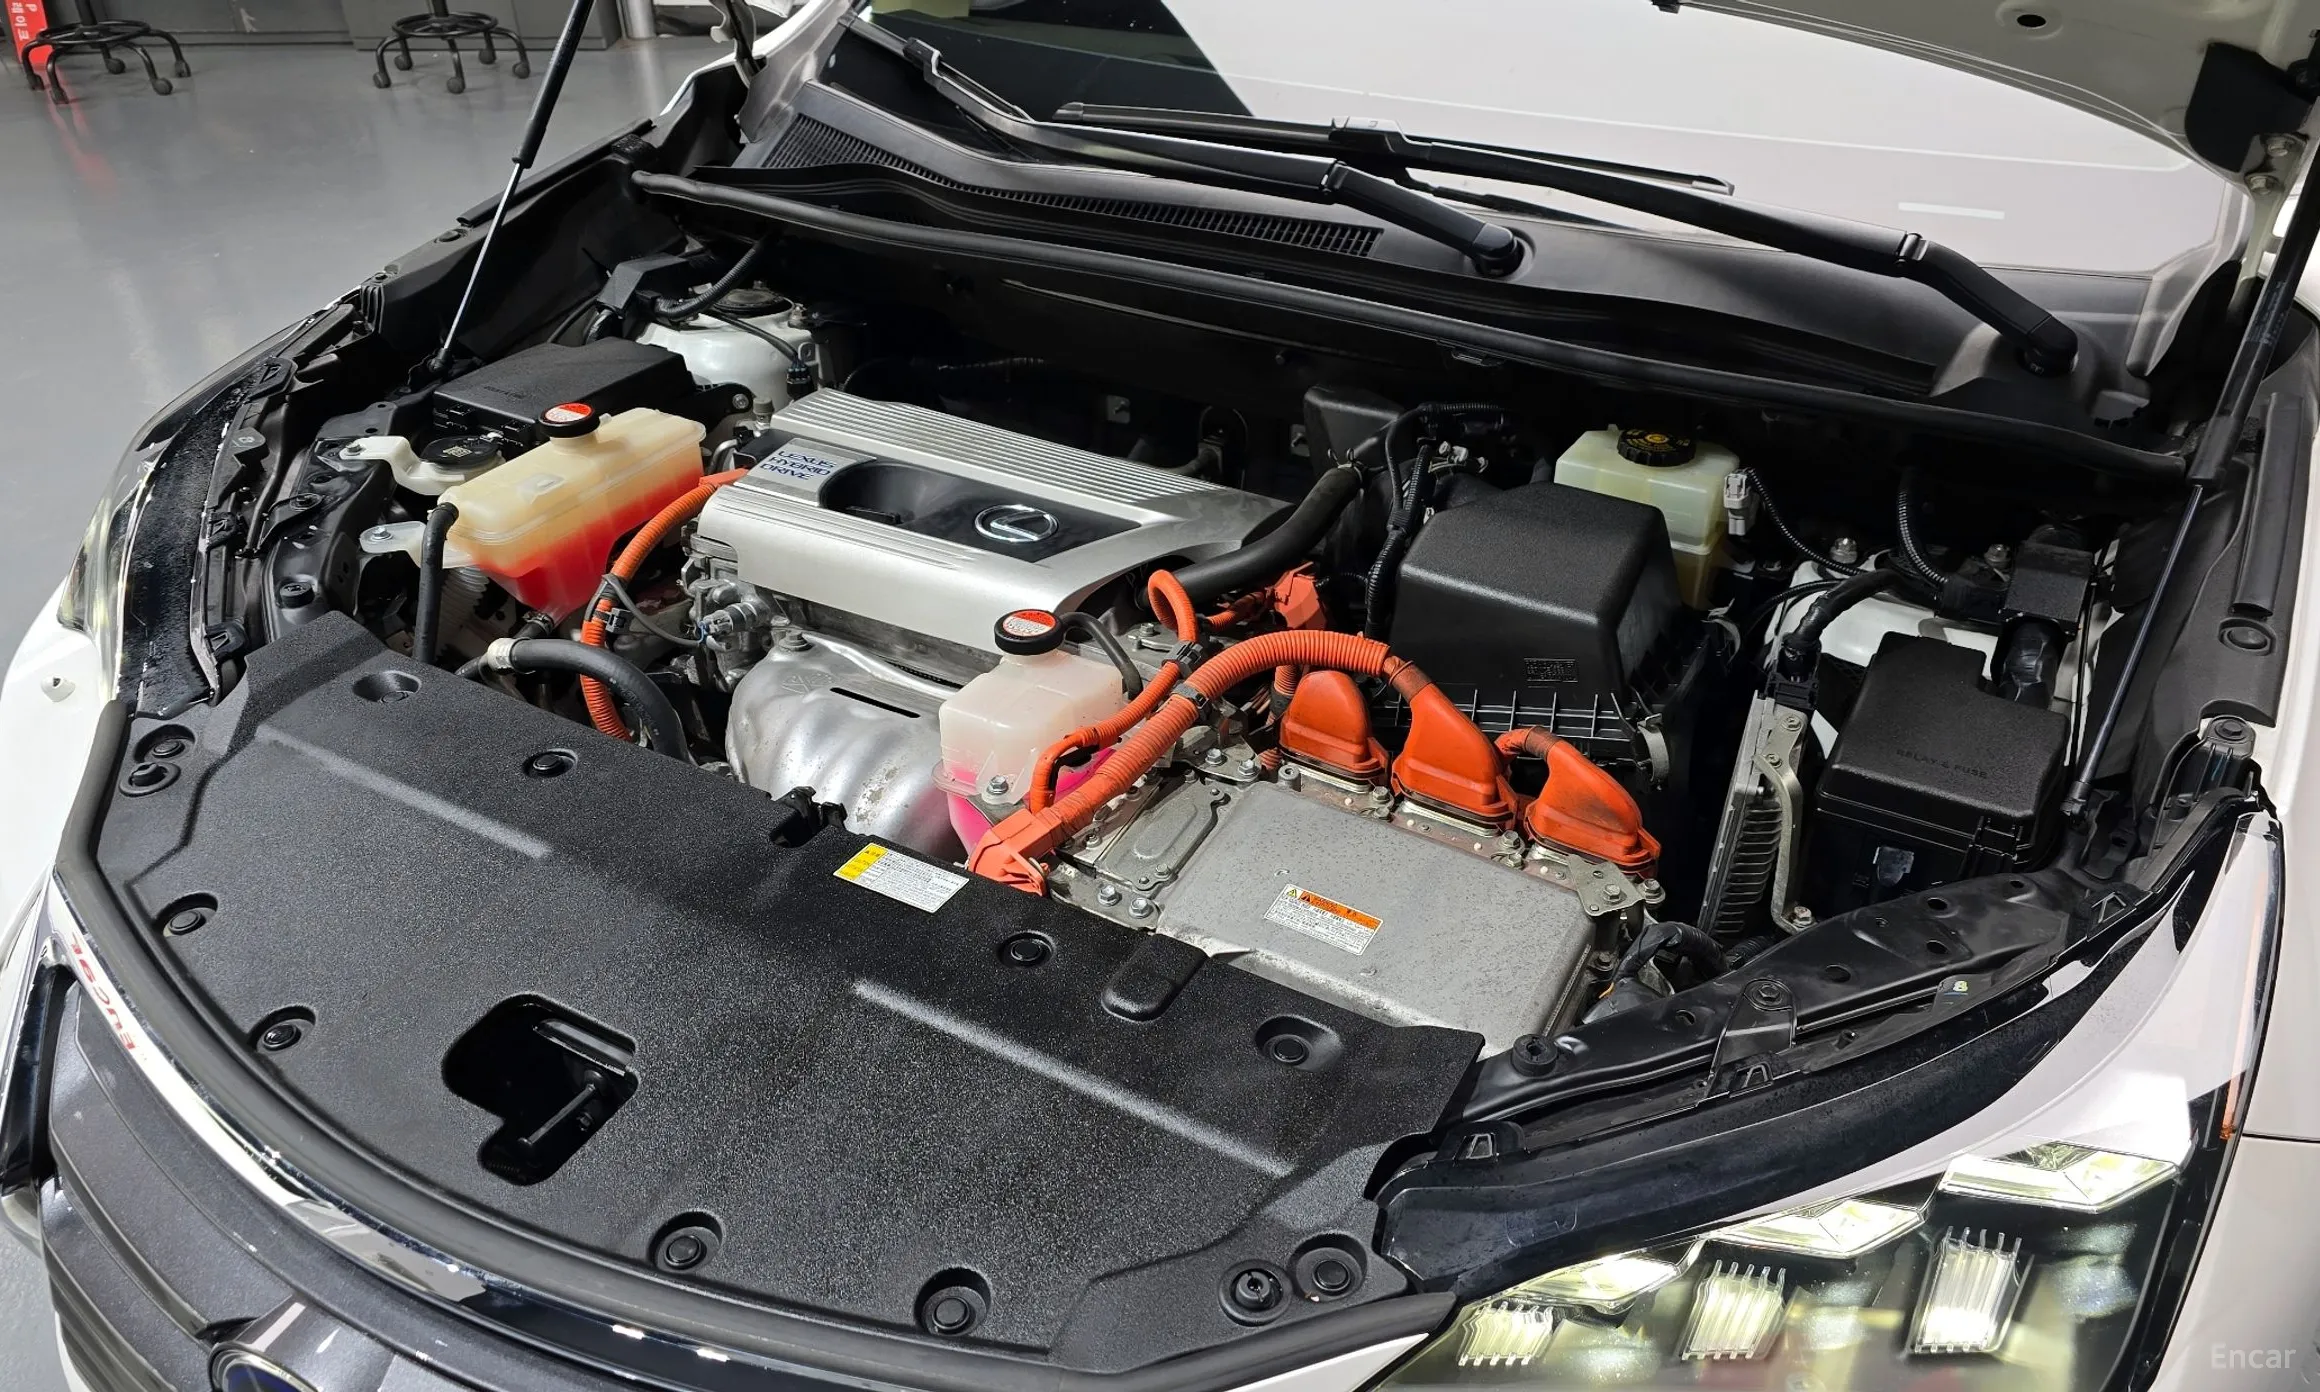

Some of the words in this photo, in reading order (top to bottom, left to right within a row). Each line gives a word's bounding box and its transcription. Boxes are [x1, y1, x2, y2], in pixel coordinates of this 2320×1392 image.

[768, 456, 832, 476] HYBRID
[778, 450, 837, 468] LEXUS
[760, 463, 814, 481] DRIVE
[1896, 748, 1938, 764] RELAY
[1954, 764, 1988, 780] FUSE
